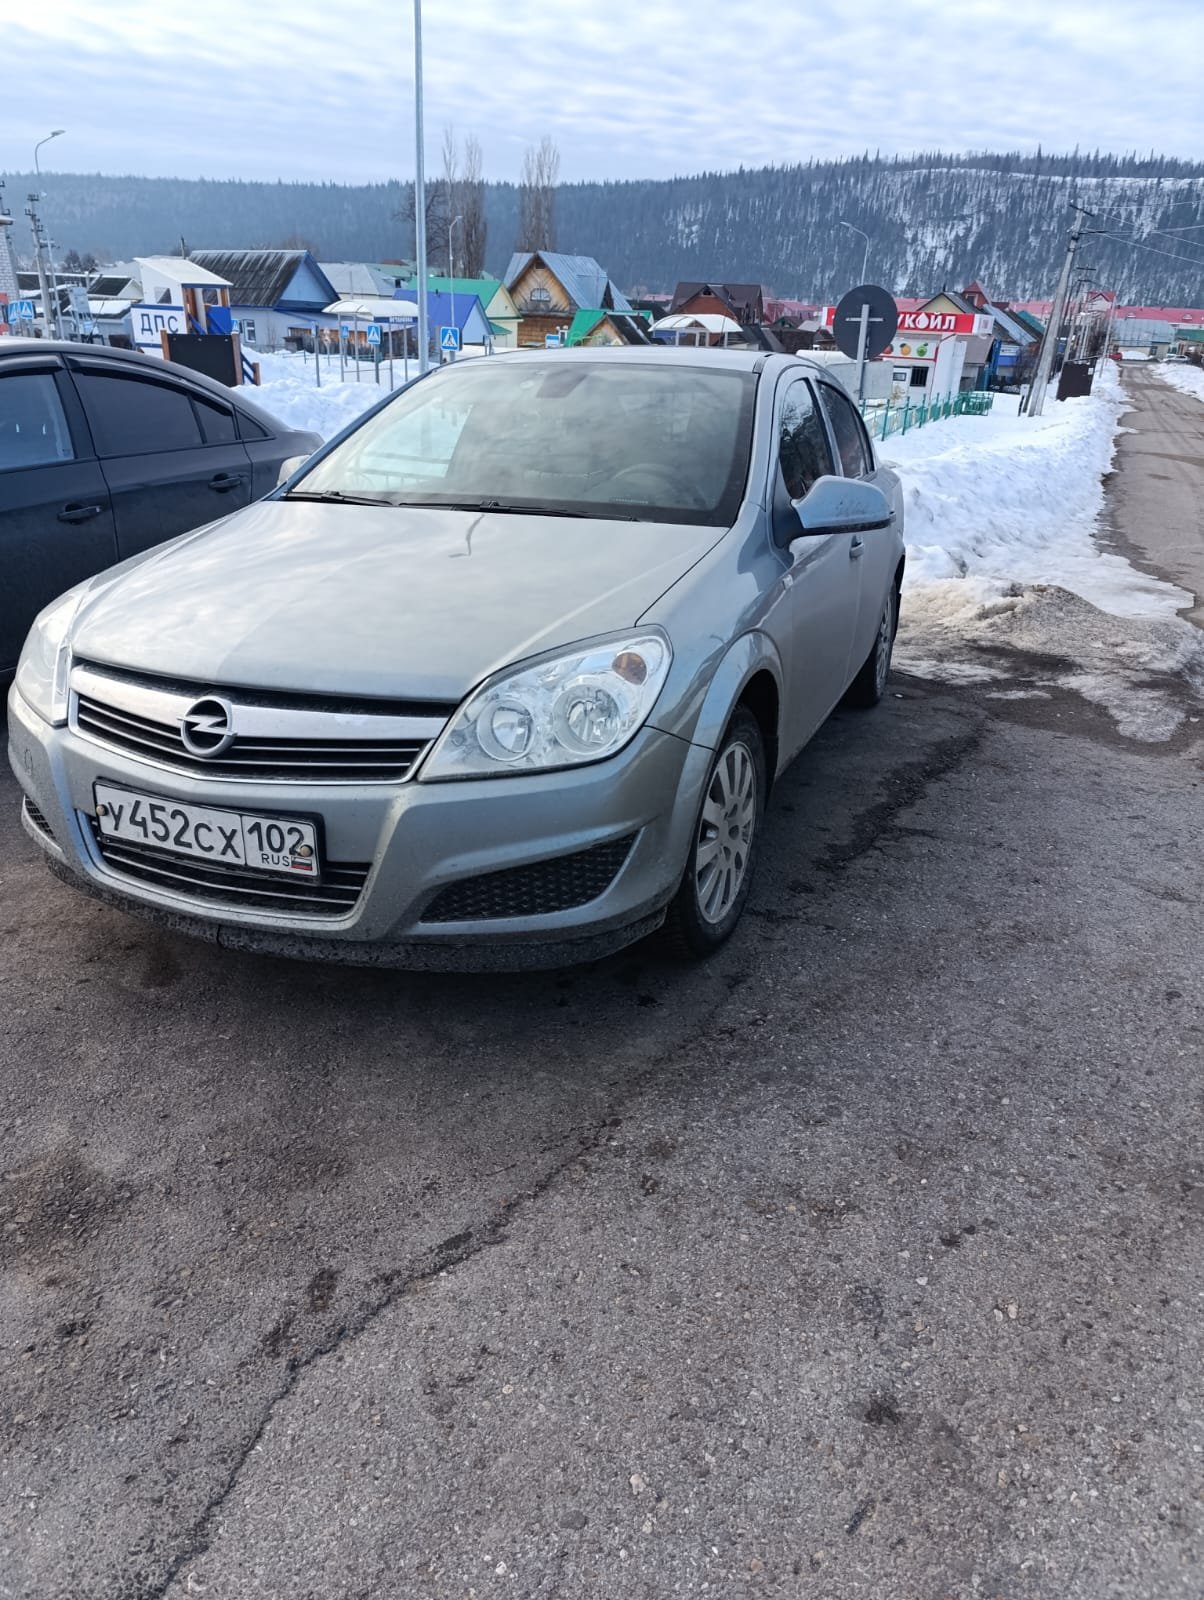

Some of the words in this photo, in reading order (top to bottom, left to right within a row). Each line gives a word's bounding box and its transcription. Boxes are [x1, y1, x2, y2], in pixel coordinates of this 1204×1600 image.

[141, 313, 179, 335] ДПС
[107, 800, 241, 859] У452СХ
[247, 821, 305, 856] 102
[261, 853, 290, 867] RUS
